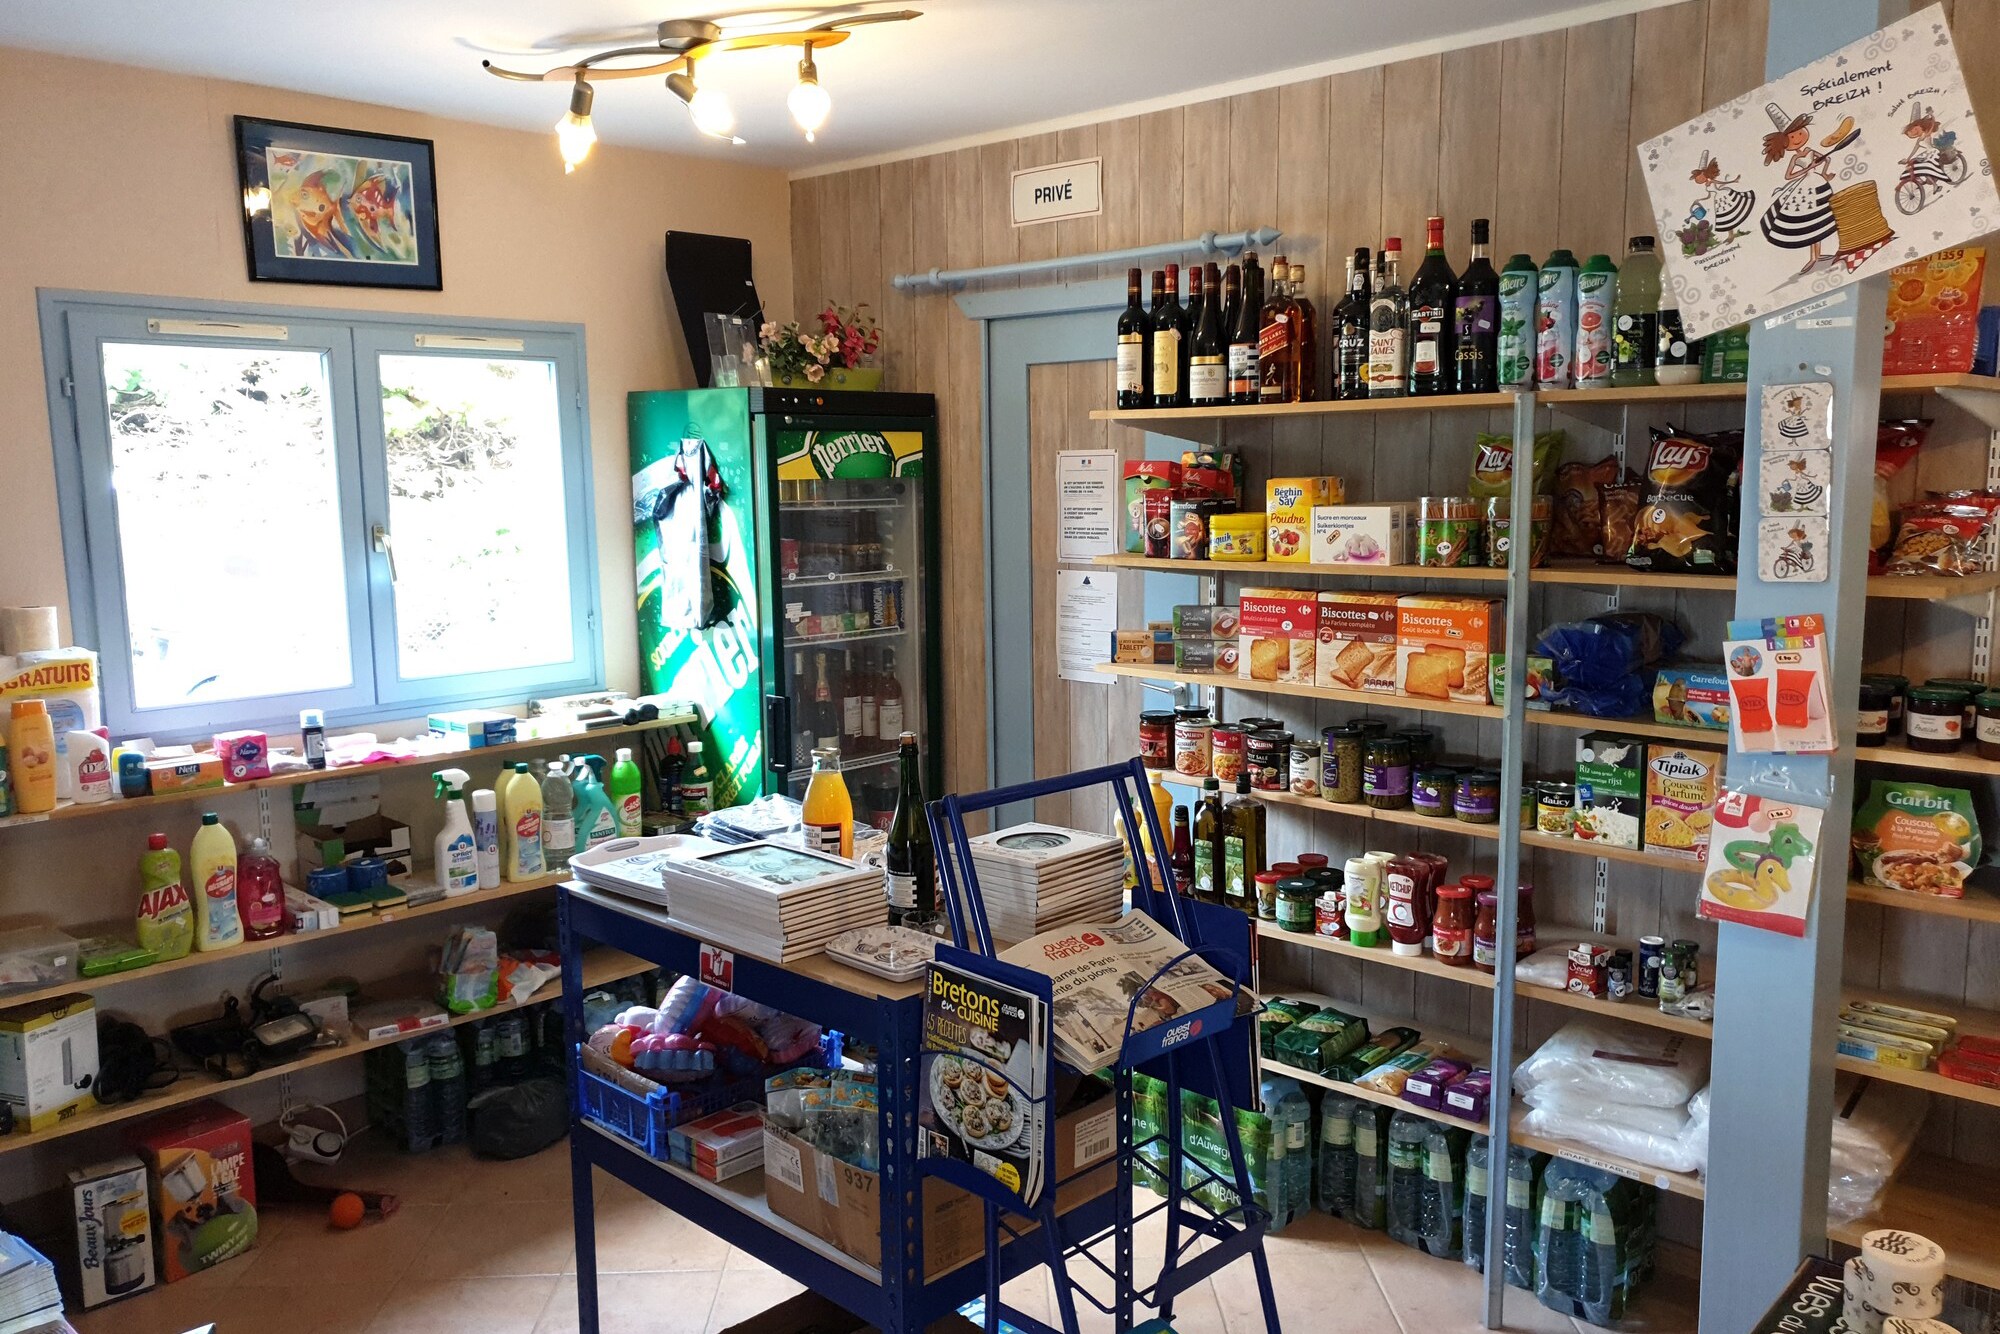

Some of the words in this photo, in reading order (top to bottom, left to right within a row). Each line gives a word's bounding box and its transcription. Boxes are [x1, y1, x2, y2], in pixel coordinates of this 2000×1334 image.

[1800, 60, 1893, 97] Spécialement
[1813, 88, 1872, 111] BREIZH
[1034, 178, 1082, 204] PRIVÉ
[1411, 309, 1443, 319] MARTINI
[1808, 300, 1828, 313] TABLE
[1269, 329, 1286, 340] LABEL
[1370, 338, 1394, 347] SAINT
[1339, 338, 1364, 348] CRUZ
[1370, 346, 1395, 355] JAMES
[1454, 349, 1484, 361] Cassis
[1650, 441, 1709, 471] Lay's
[1274, 487, 1303, 501] Béghin
[1278, 496, 1297, 508] Say
[1646, 493, 1694, 503] Barbecue
[1172, 502, 1198, 510] Carrefour
[1270, 512, 1306, 525] Poudre
[872, 586, 884, 626] ORANGINA
[1242, 600, 1287, 615] Biscottes
[1321, 606, 1367, 620] Biscottes
[1330, 620, 1348, 628] Farine
[1348, 621, 1376, 629] complète
[1402, 612, 1453, 628] Biscottes
[6, 662, 92, 691] GRATUITS
[1690, 674, 1728, 685] Carrefour
[1250, 739, 1274, 750] SAURIN
[176, 763, 201, 776] Nett
[1579, 764, 1590, 774] Riz
[1657, 759, 1701, 777] Tipiak
[1608, 777, 1623, 787] rijst
[1662, 778, 1708, 792] Couscous
[1542, 794, 1571, 808] d'aucy
[1662, 786, 1708, 801] Parfumé
[1885, 791, 1952, 811] Garbit
[1390, 881, 1413, 894] KETCHUP
[137, 883, 189, 919] AJAX
[1042, 935, 1081, 954] ouest
[1044, 943, 1090, 962] france
[1077, 963, 1090, 977] de
[1091, 955, 1116, 970] Paris
[1568, 961, 1594, 976] Secret
[1073, 976, 1089, 988] du
[1089, 966, 1118, 984] plomb
[932, 970, 1000, 1018] Bretons
[941, 999, 956, 1013] en
[957, 1005, 999, 1032] CUISINE
[926, 1012, 935, 1031] 65
[937, 1016, 967, 1044] RECETTES
[1166, 1020, 1191, 1038] ouest
[1161, 1030, 1189, 1049] france
[1189, 1134, 1231, 1161] d'Auverg
[211, 1152, 246, 1174] LAMPE
[1559, 1150, 1592, 1166] DRAPS
[1591, 1158, 1640, 1179] JETABLES
[844, 1168, 874, 1193] 937
[1219, 1185, 1243, 1207] BAR
[78, 1189, 103, 1227] Jours
[81, 1224, 101, 1270] Beaux
[199, 1237, 236, 1265] TWINY
